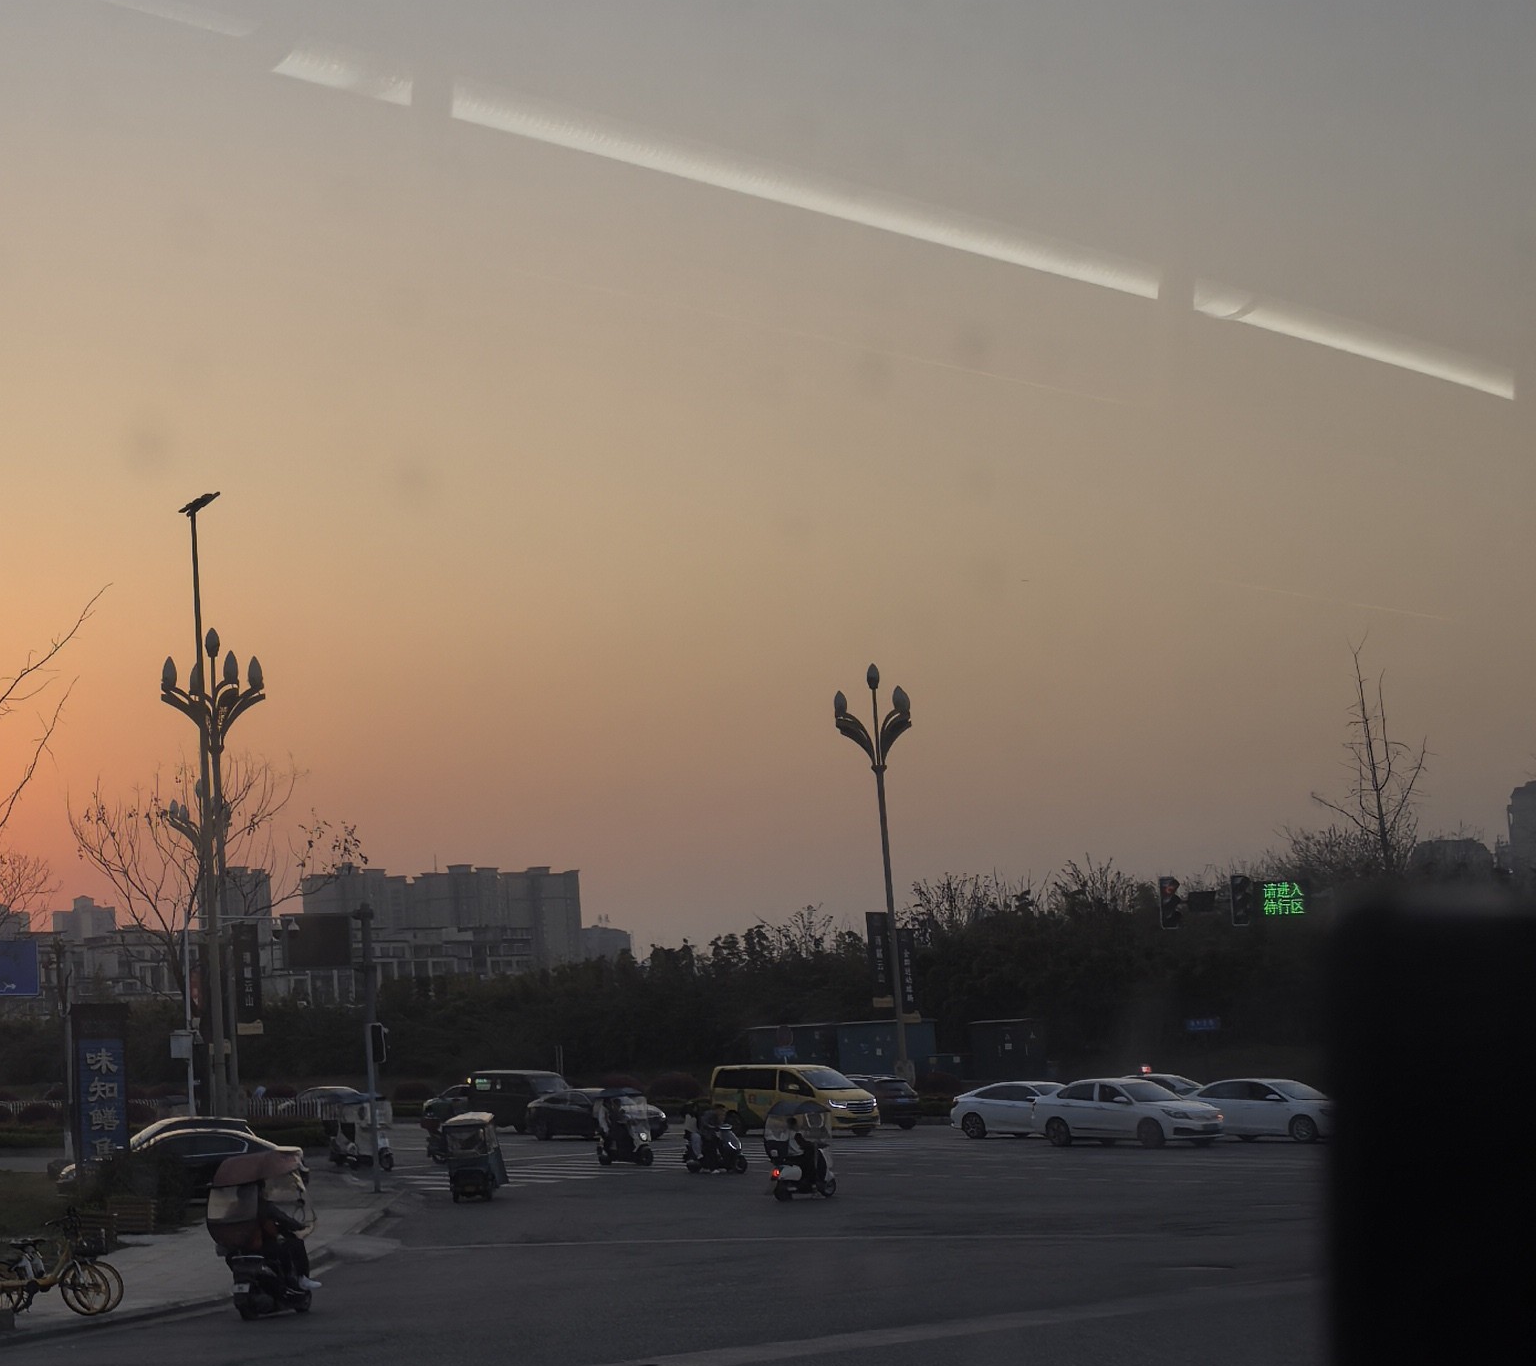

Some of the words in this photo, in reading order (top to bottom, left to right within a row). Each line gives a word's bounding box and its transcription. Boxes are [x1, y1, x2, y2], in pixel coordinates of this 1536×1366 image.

[1263, 881, 1305, 898] 请进入
[1263, 898, 1305, 915] 待行区
